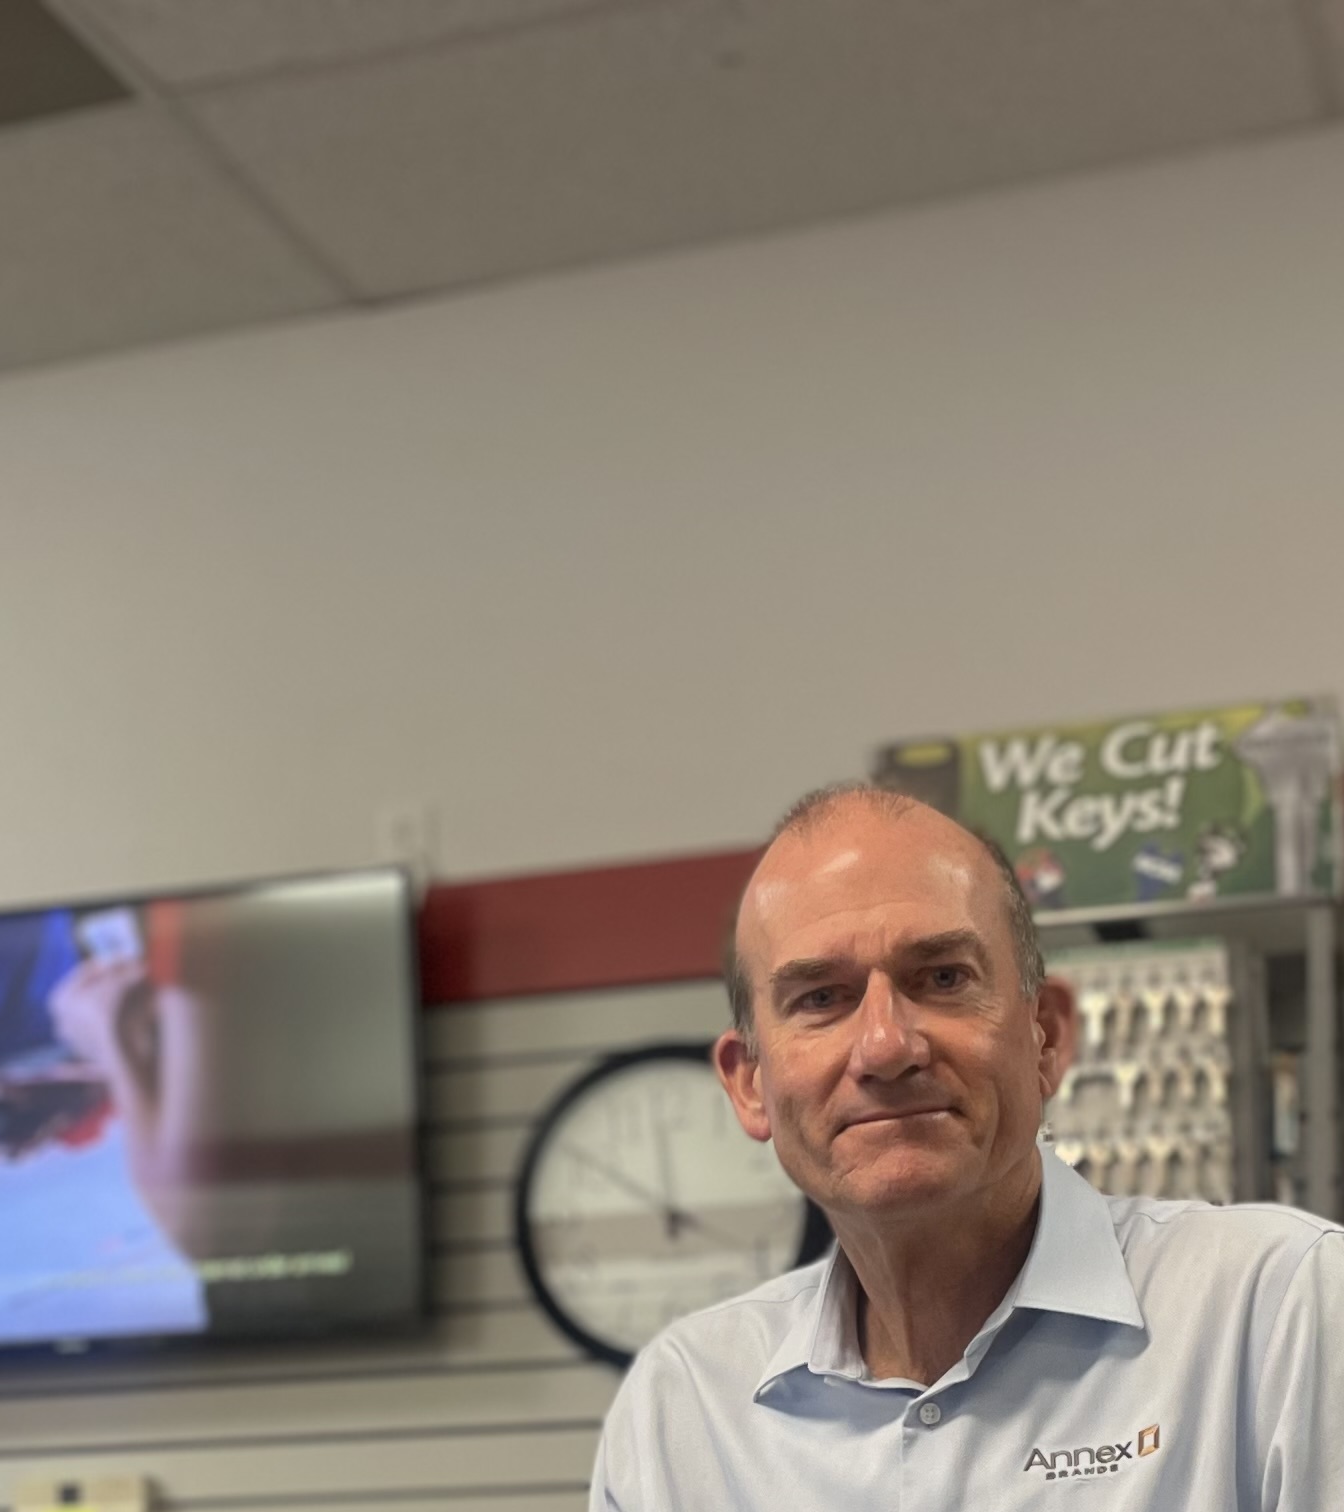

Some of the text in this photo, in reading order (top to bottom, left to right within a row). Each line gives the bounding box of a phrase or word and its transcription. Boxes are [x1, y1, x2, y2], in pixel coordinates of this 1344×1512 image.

[979, 720, 1221, 792] We Cut
[1016, 776, 1185, 851] Keys!
[1023, 1441, 1133, 1471] Annex
[1045, 1463, 1119, 1480] BRANDS
